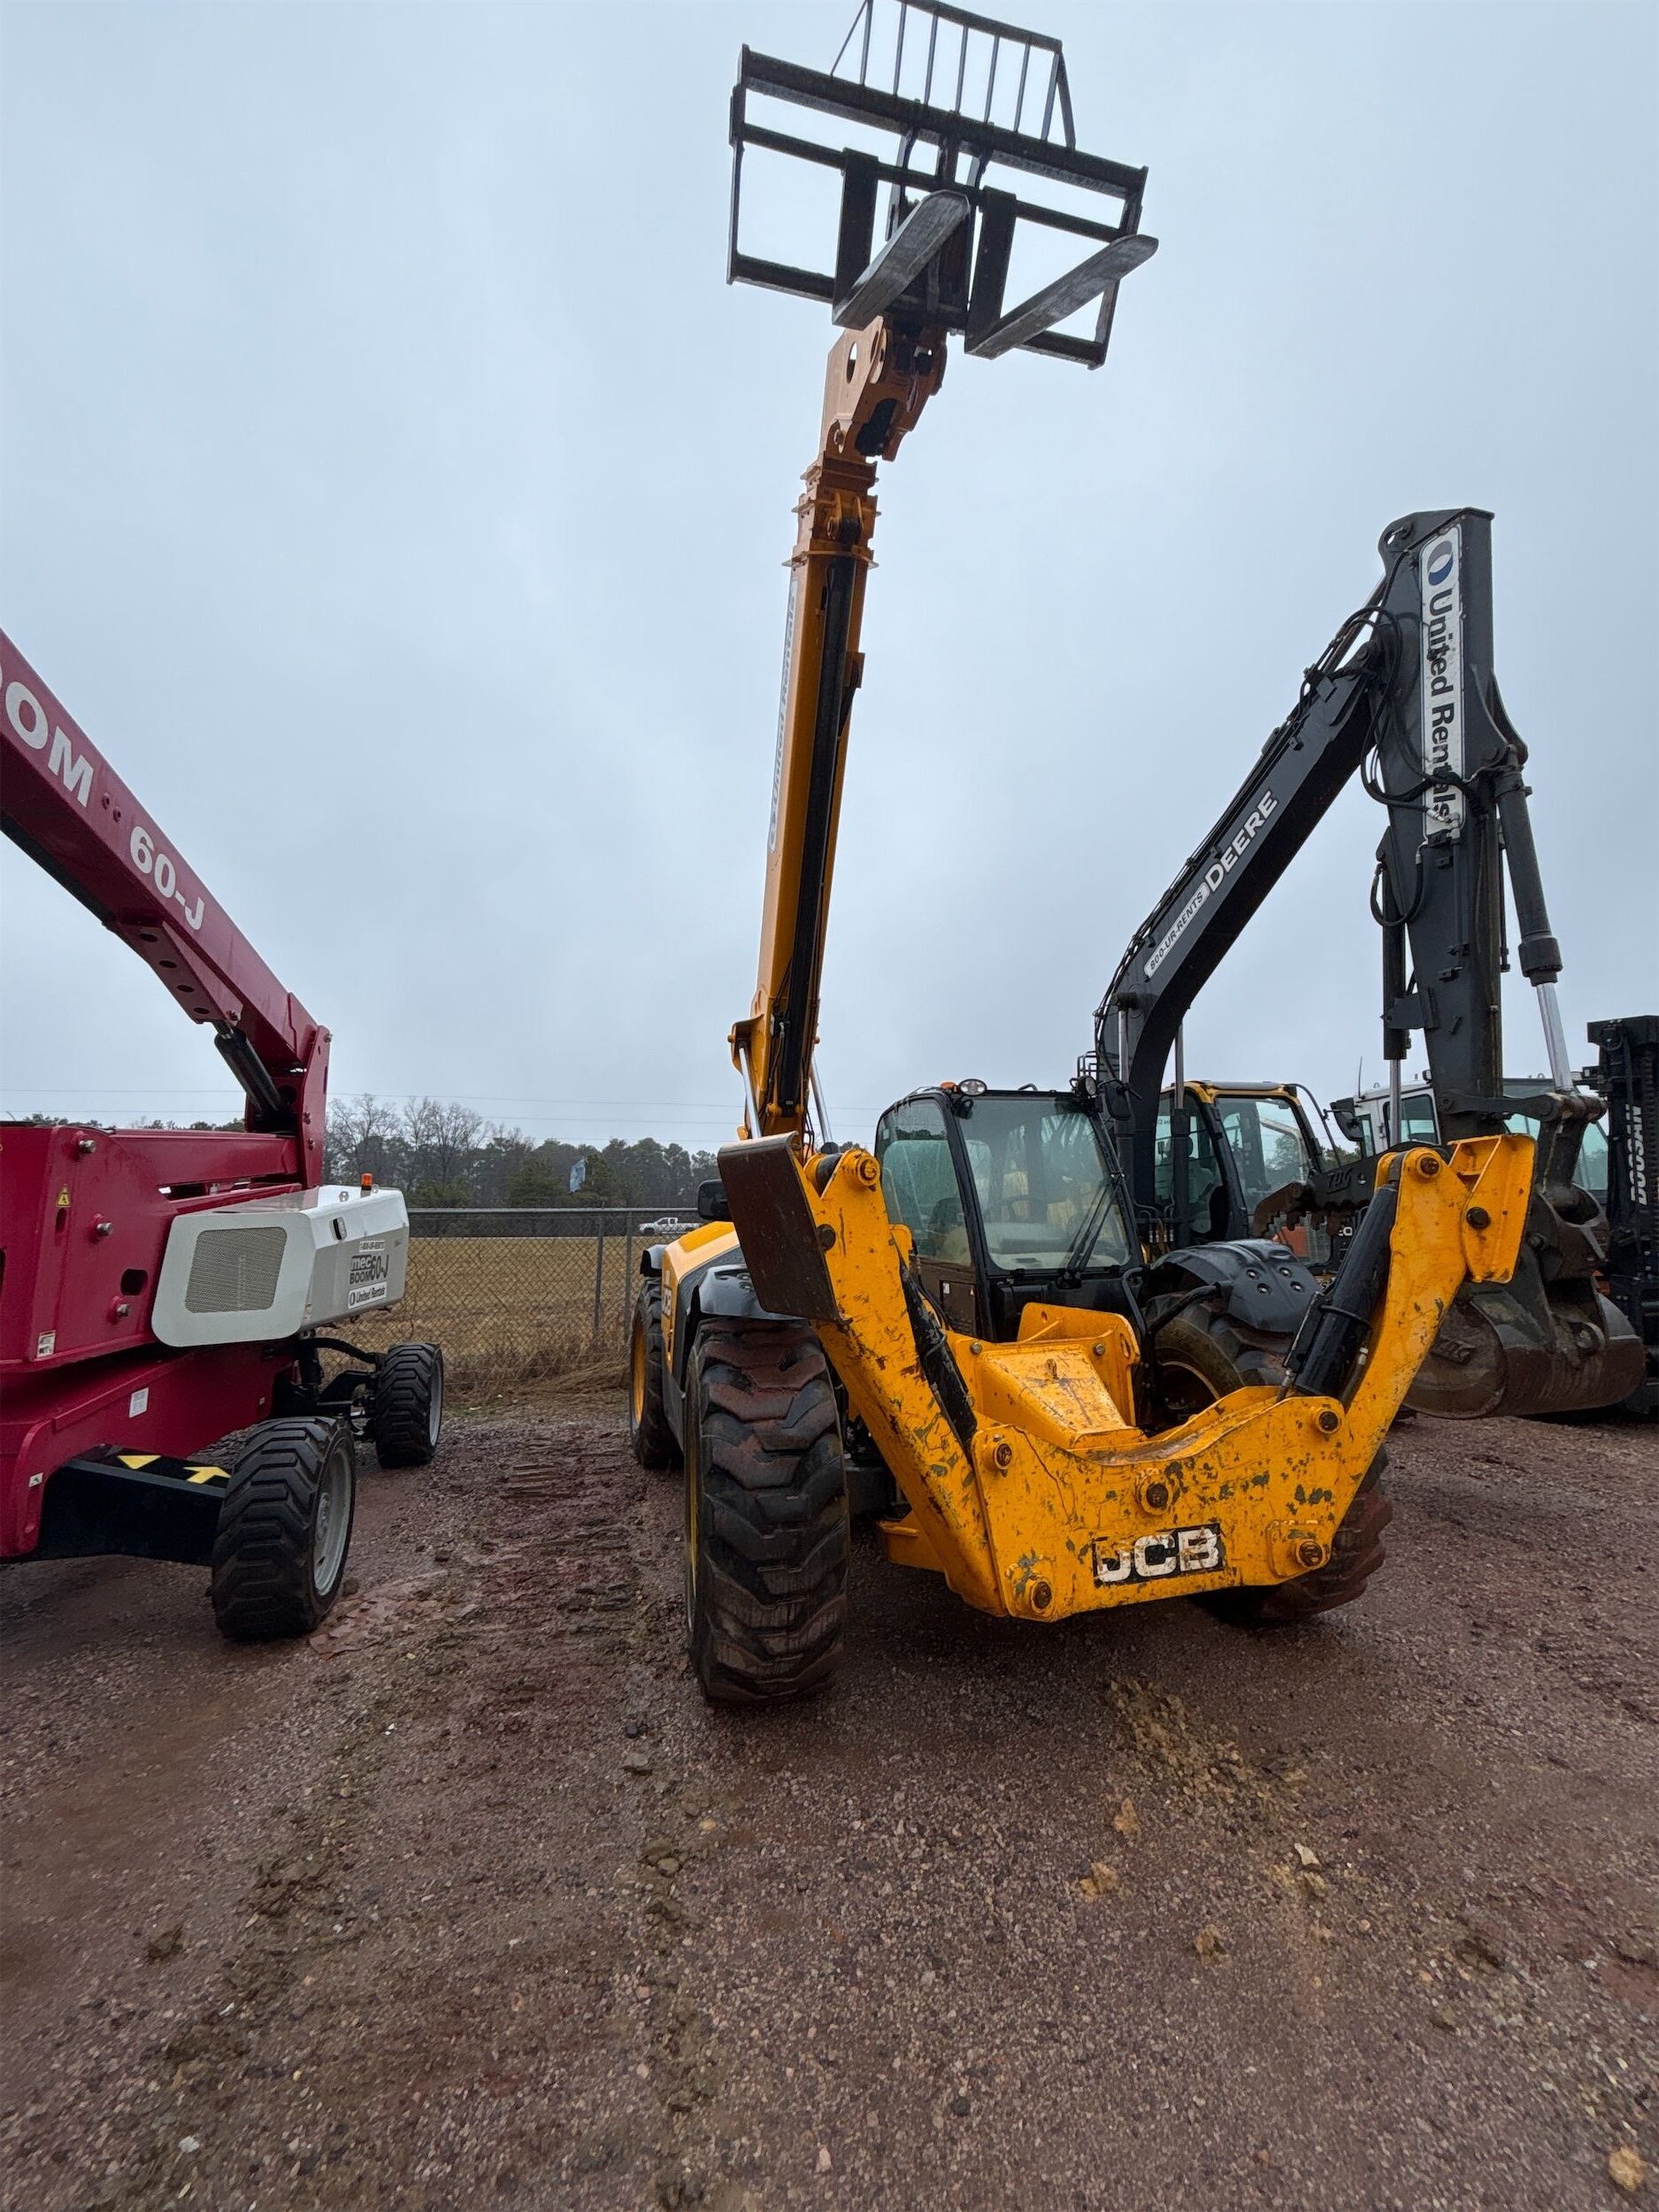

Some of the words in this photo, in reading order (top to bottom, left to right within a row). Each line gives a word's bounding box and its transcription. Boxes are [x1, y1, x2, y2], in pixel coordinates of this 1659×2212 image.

[1429, 588, 1454, 696] United
[0, 667, 94, 808] OM
[130, 826, 204, 930] 60-J
[1205, 791, 1278, 892] DEERE
[1624, 1103, 1647, 1205] DOOSAN
[1095, 1528, 1218, 1582] JCB
